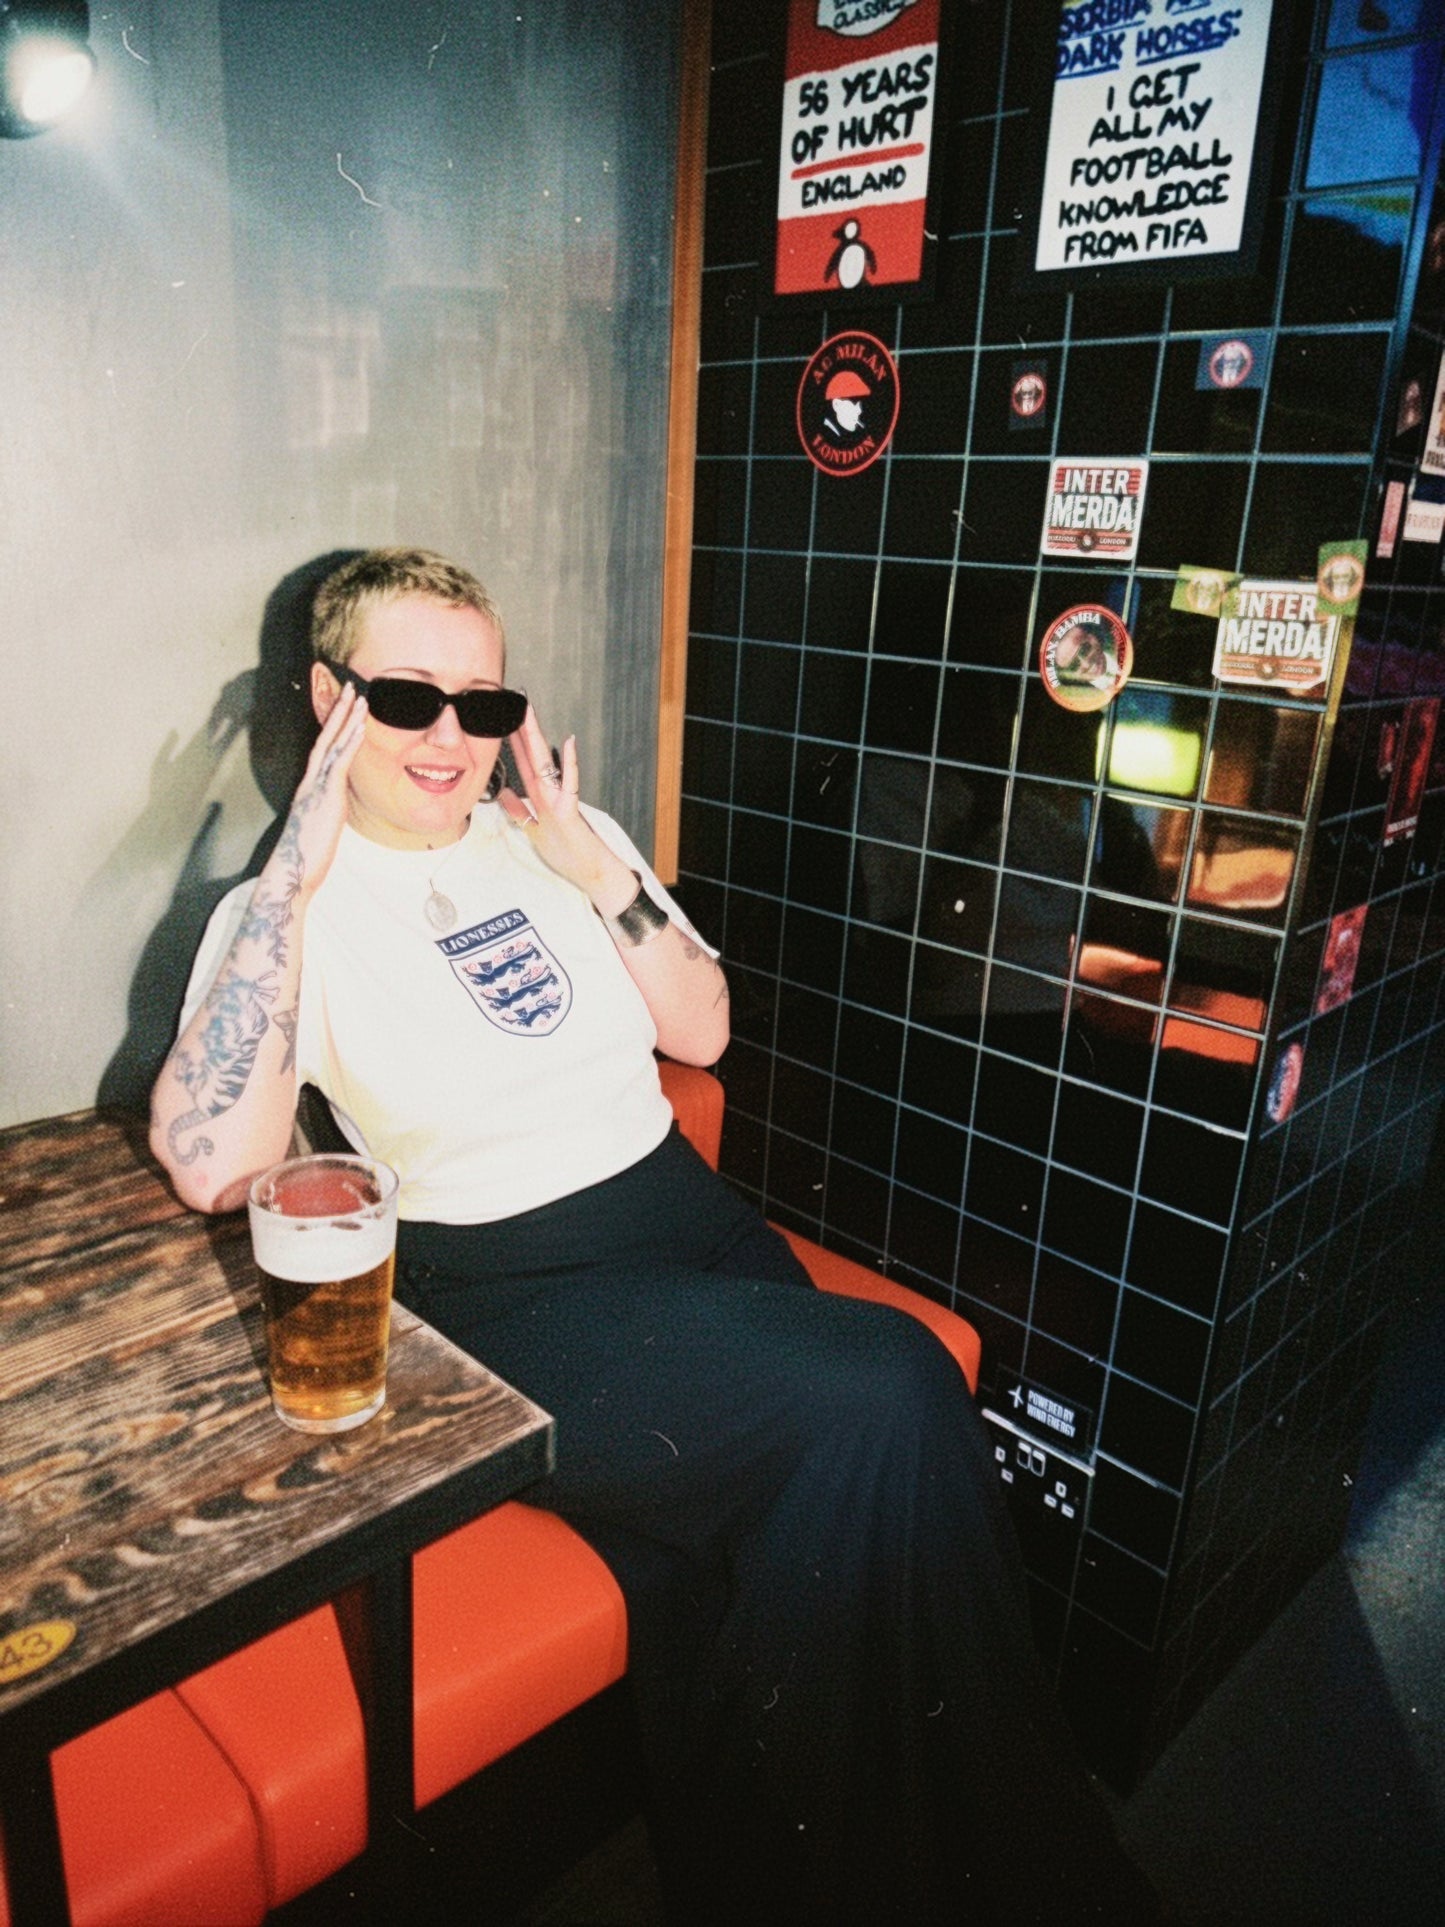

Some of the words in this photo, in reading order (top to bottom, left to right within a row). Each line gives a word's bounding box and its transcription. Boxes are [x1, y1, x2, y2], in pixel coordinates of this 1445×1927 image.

[1055, 31, 1126, 74] DARK
[798, 80, 829, 118] 56
[841, 53, 933, 108] YEARS
[1107, 86, 1115, 112] I
[1129, 62, 1202, 110] GET
[791, 125, 829, 165] OF
[838, 96, 928, 150] HURT
[1088, 112, 1153, 148] ALL
[1157, 97, 1213, 137] MY
[1070, 138, 1233, 188] FOOTBALL
[800, 164, 907, 209] ENGLAND
[1058, 173, 1231, 229] KNOWLEDGE
[1063, 230, 1139, 264] FROM
[1146, 217, 1208, 252] FIFA
[813, 357, 833, 385] AC
[836, 343, 888, 382] MILAN
[812, 433, 875, 465] LONDON
[1063, 469, 1130, 494] INTER
[1049, 494, 1136, 531] MERDA
[1099, 537, 1127, 545] LONDON
[1238, 592, 1317, 621] INTER
[1224, 619, 1325, 661] MERDA
[441, 912, 524, 952] LIONESSES
[1027, 1402, 1047, 1424] WIND
[1047, 1413, 1076, 1438] ENERGY
[1028, 1389, 1064, 1419] POWERED
[1063, 1407, 1075, 1424] BY
